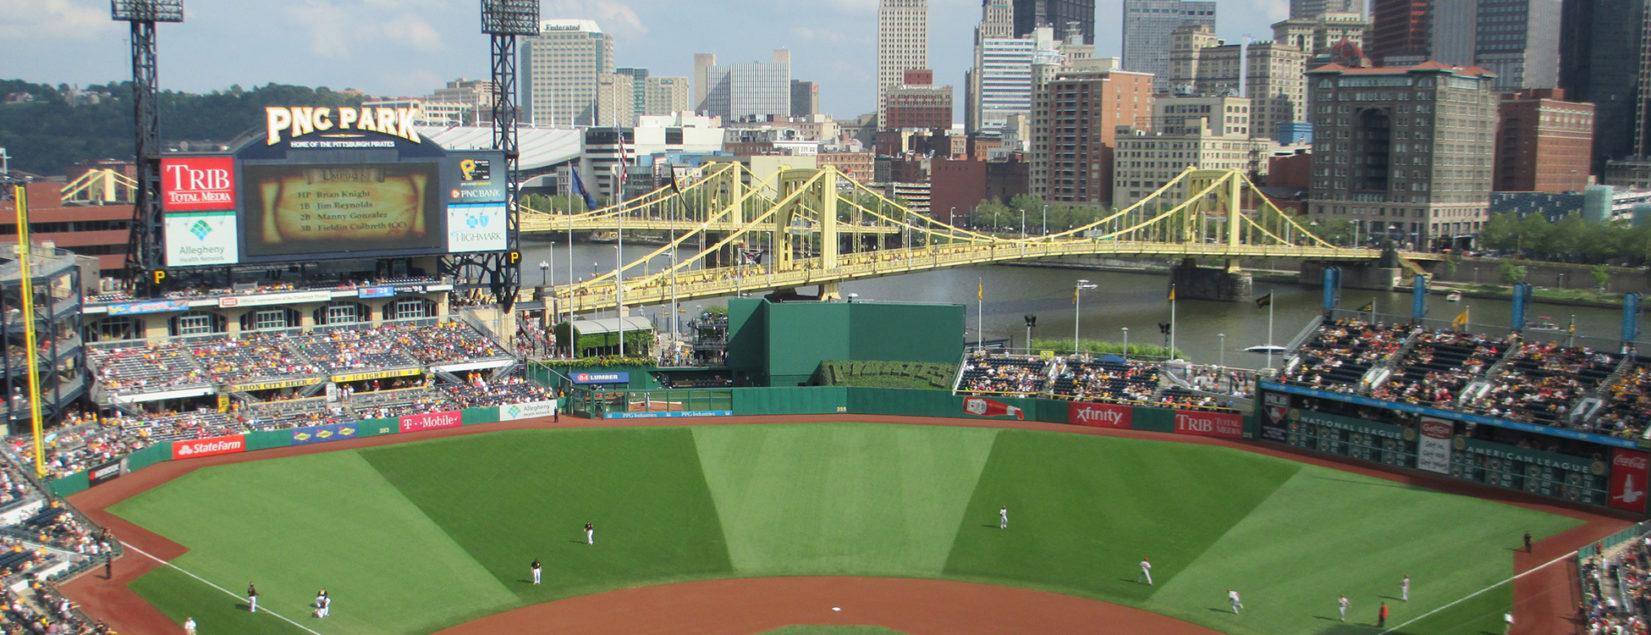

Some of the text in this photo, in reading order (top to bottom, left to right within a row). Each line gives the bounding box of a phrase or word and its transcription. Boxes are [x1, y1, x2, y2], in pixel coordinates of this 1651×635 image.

[264, 106, 421, 146] PNC PARK
[166, 164, 230, 190] TRIB
[168, 191, 231, 202] TOTAL MEDIA
[341, 191, 370, 199] Knight
[461, 189, 500, 198] PNC BANK
[334, 201, 373, 210] Reynolds
[456, 232, 502, 241] HIGHMARK
[179, 246, 224, 255] Allegheny
[511, 252, 519, 264] P
[154, 271, 165, 284] P
[285, 379, 308, 387] BEER
[1077, 407, 1123, 424] xfinity
[1176, 414, 1212, 432] TRIB
[1301, 417, 1400, 439] NATIONAL LEAGUE
[1466, 447, 1590, 473] AMERICAN LEAGUE
